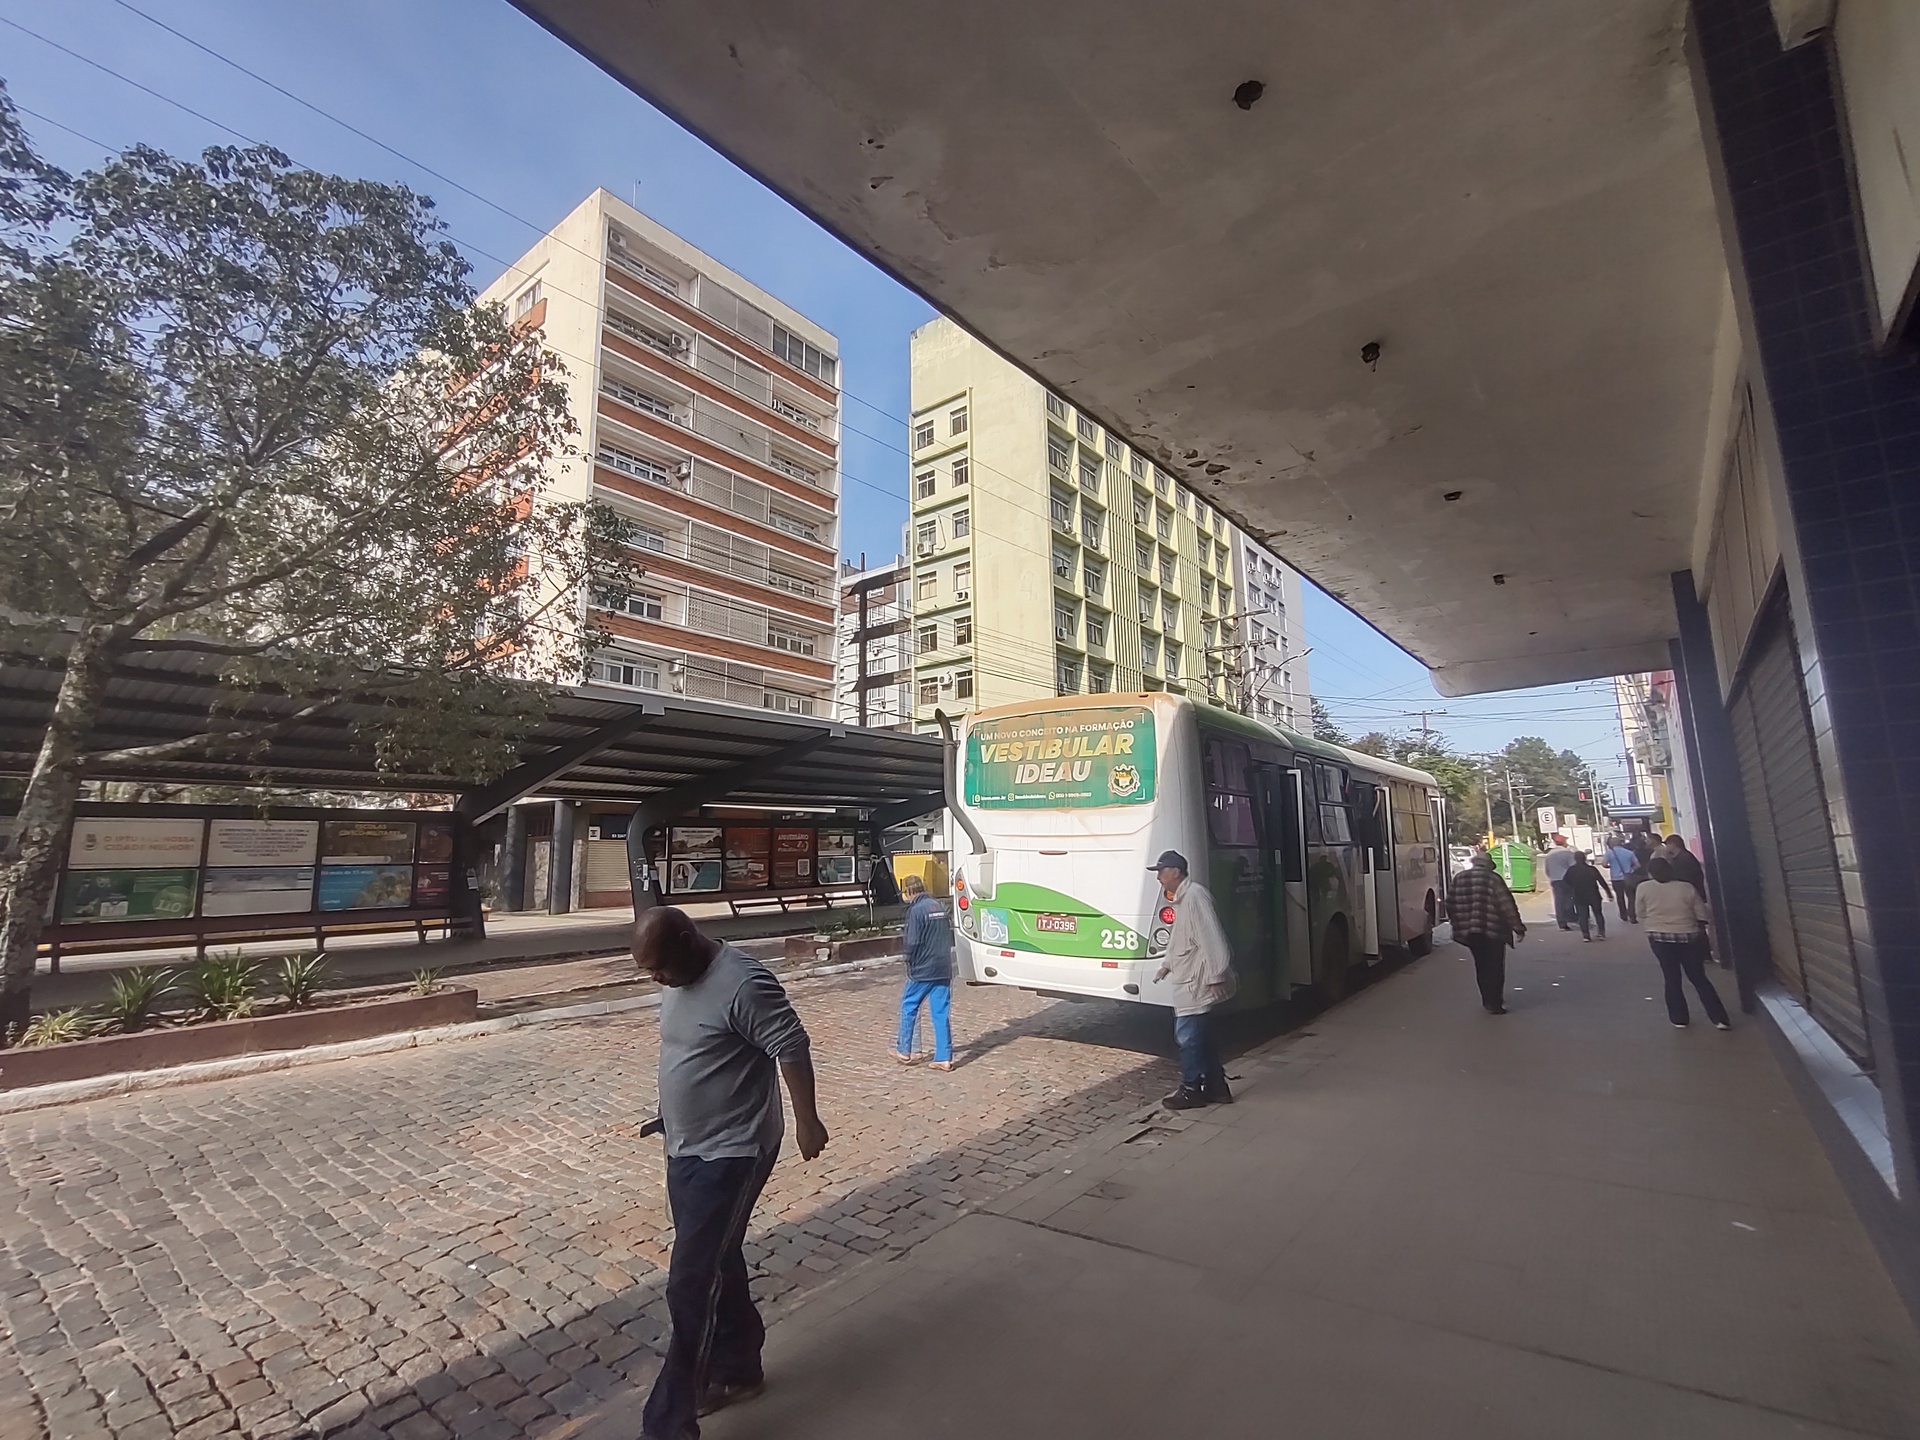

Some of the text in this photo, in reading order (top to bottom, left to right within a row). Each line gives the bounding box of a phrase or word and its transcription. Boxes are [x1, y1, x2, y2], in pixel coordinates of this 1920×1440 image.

[981, 720, 1134, 741] UM NOVO CONCEITO NA FORMAÇÃO
[980, 734, 1134, 764] VESTIBULAR
[1014, 760, 1092, 785] IDEAU
[1100, 928, 1140, 951] 258
